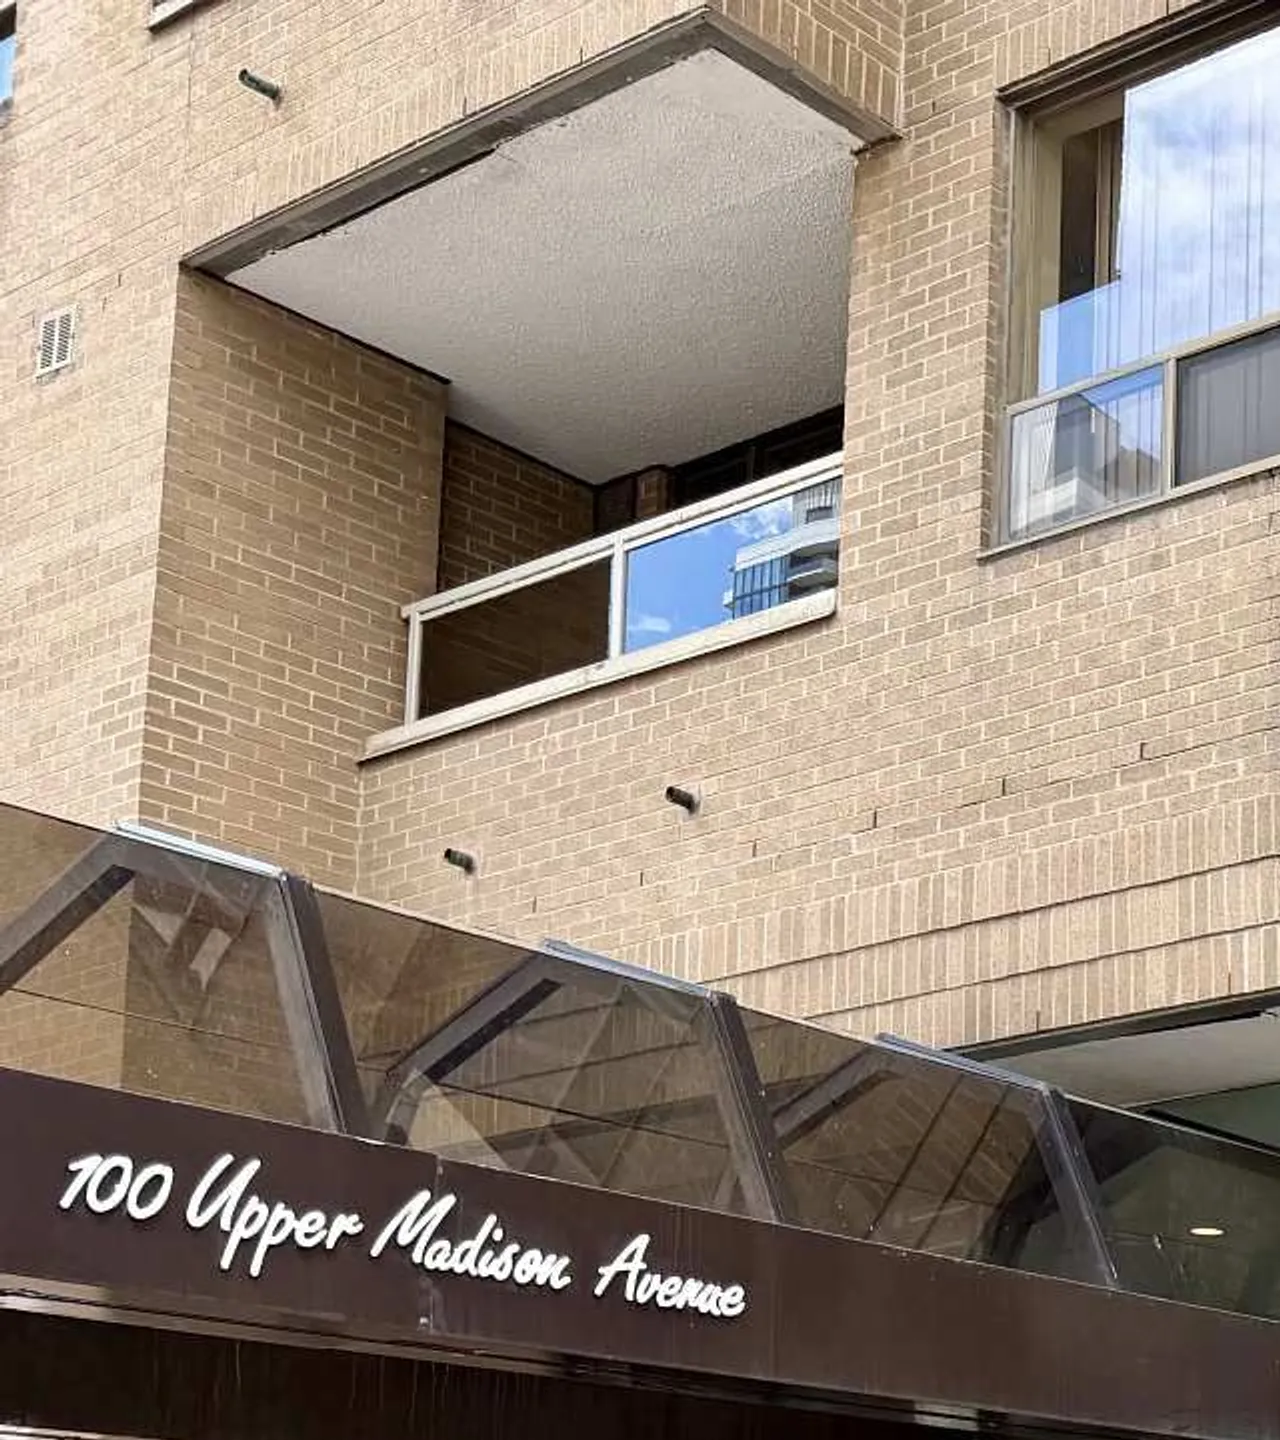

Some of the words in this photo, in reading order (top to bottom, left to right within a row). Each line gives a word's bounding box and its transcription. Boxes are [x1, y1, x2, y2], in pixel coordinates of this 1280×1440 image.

[59, 1154, 174, 1220] 100
[186, 1154, 364, 1277] Upper
[369, 1189, 572, 1289] Madison
[594, 1233, 745, 1316] Avenue
